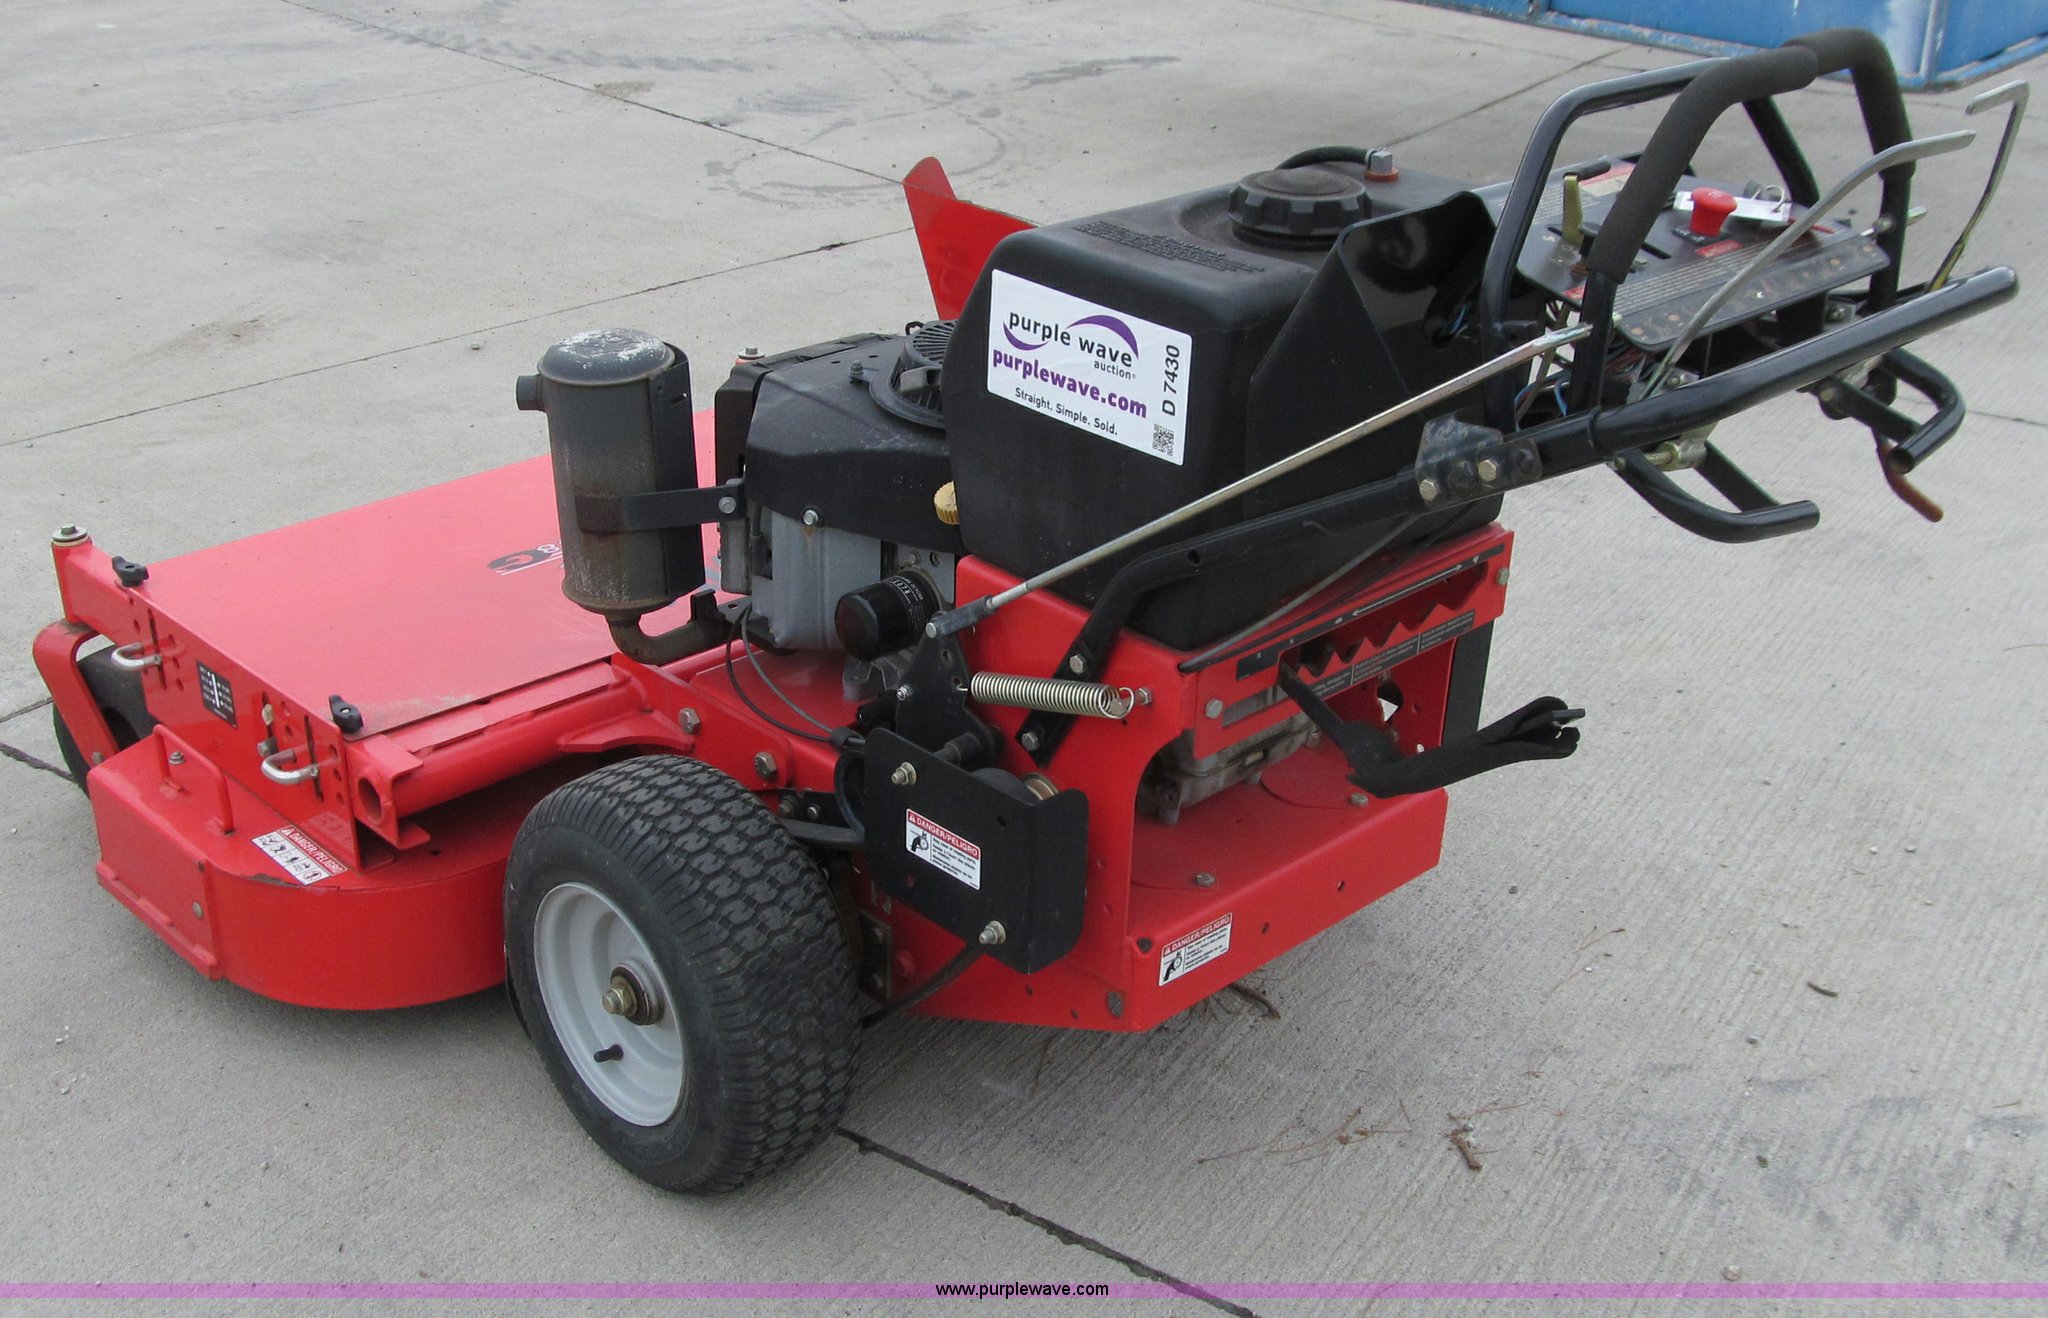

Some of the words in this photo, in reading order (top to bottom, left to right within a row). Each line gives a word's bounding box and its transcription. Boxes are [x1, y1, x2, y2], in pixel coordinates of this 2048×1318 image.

[1009, 311, 1071, 346] purple
[1078, 336, 1133, 368] wave
[992, 349, 1147, 418] purplewave.com
[1163, 344, 1180, 395] 7430
[1015, 387, 1053, 411] Straight.
[1055, 403, 1091, 426] Simple.
[1094, 418, 1118, 436] Sold.
[1162, 401, 1176, 417] D
